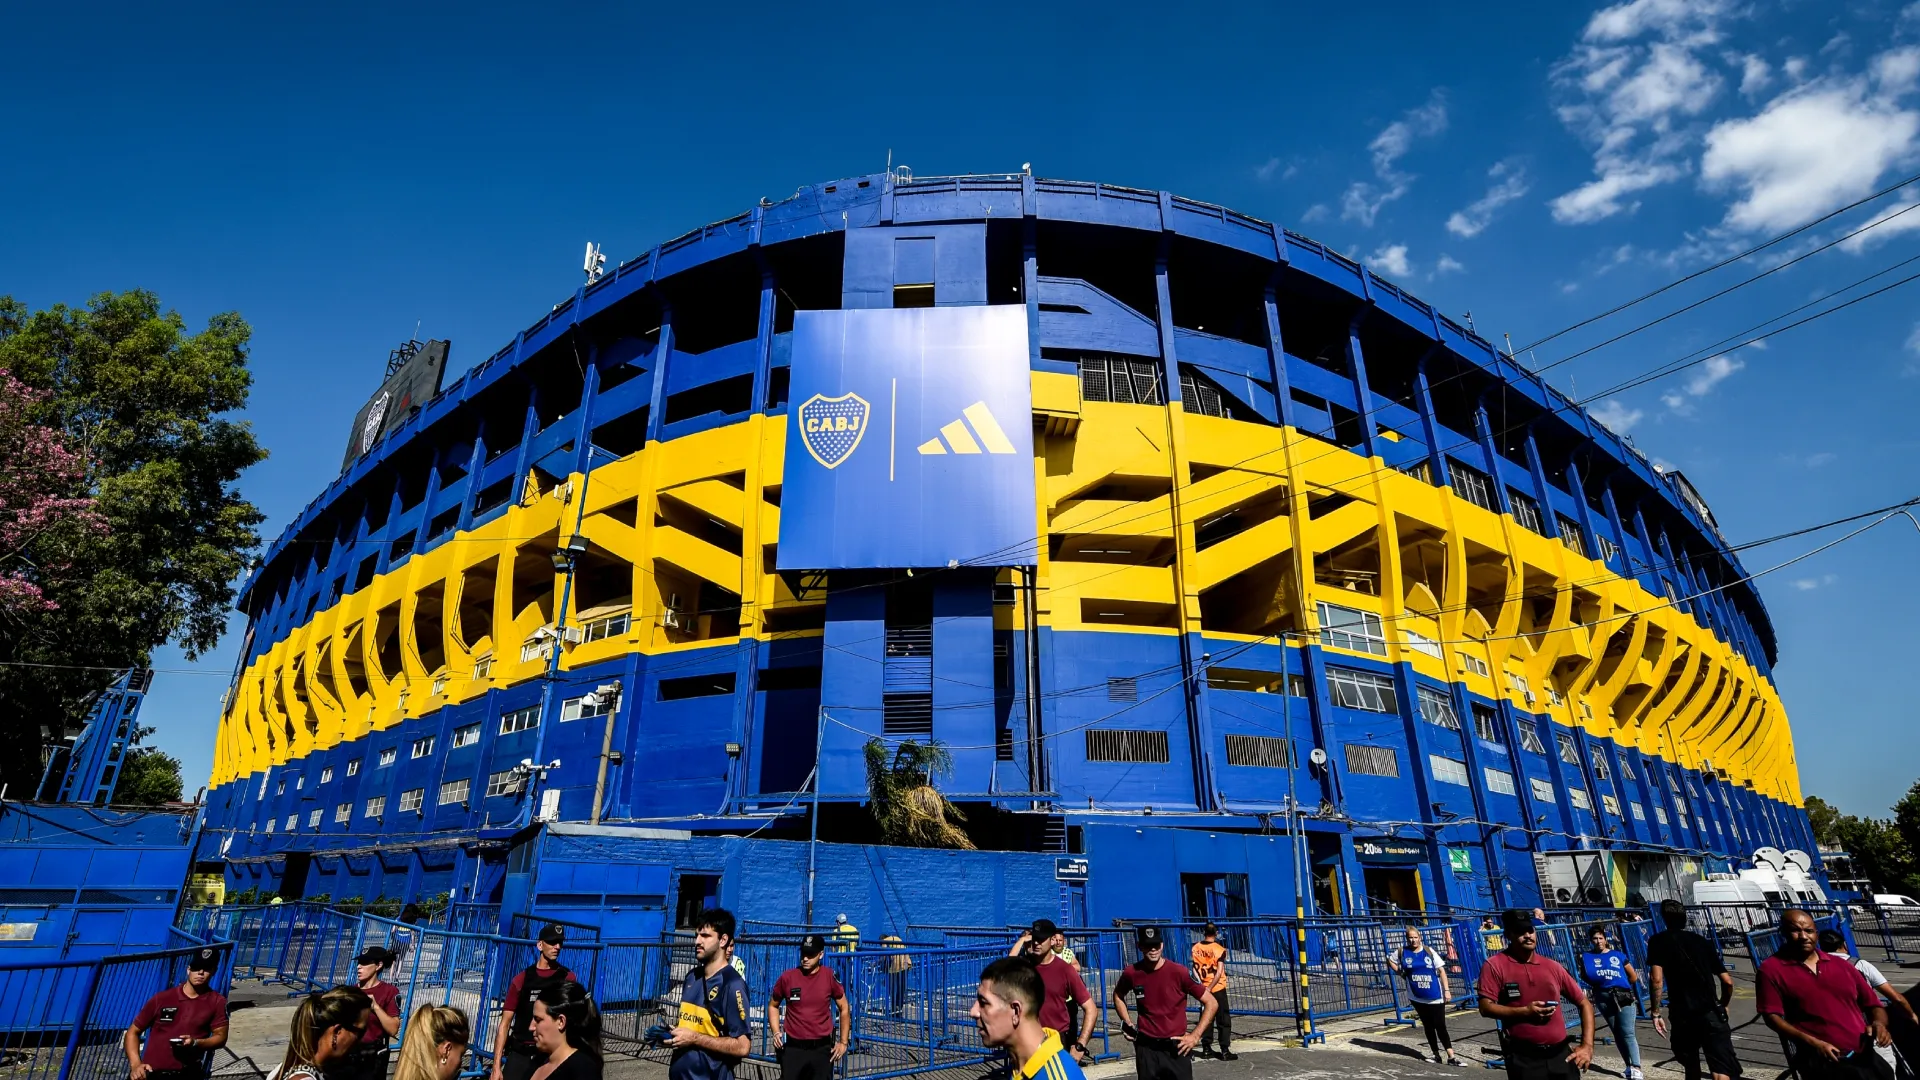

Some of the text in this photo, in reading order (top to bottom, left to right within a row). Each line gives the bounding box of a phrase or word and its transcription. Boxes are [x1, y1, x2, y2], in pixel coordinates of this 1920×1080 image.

[807, 416, 860, 433] CABJ
[1411, 974, 1433, 982] CONTROL
[1596, 969, 1622, 978] CONTROL
